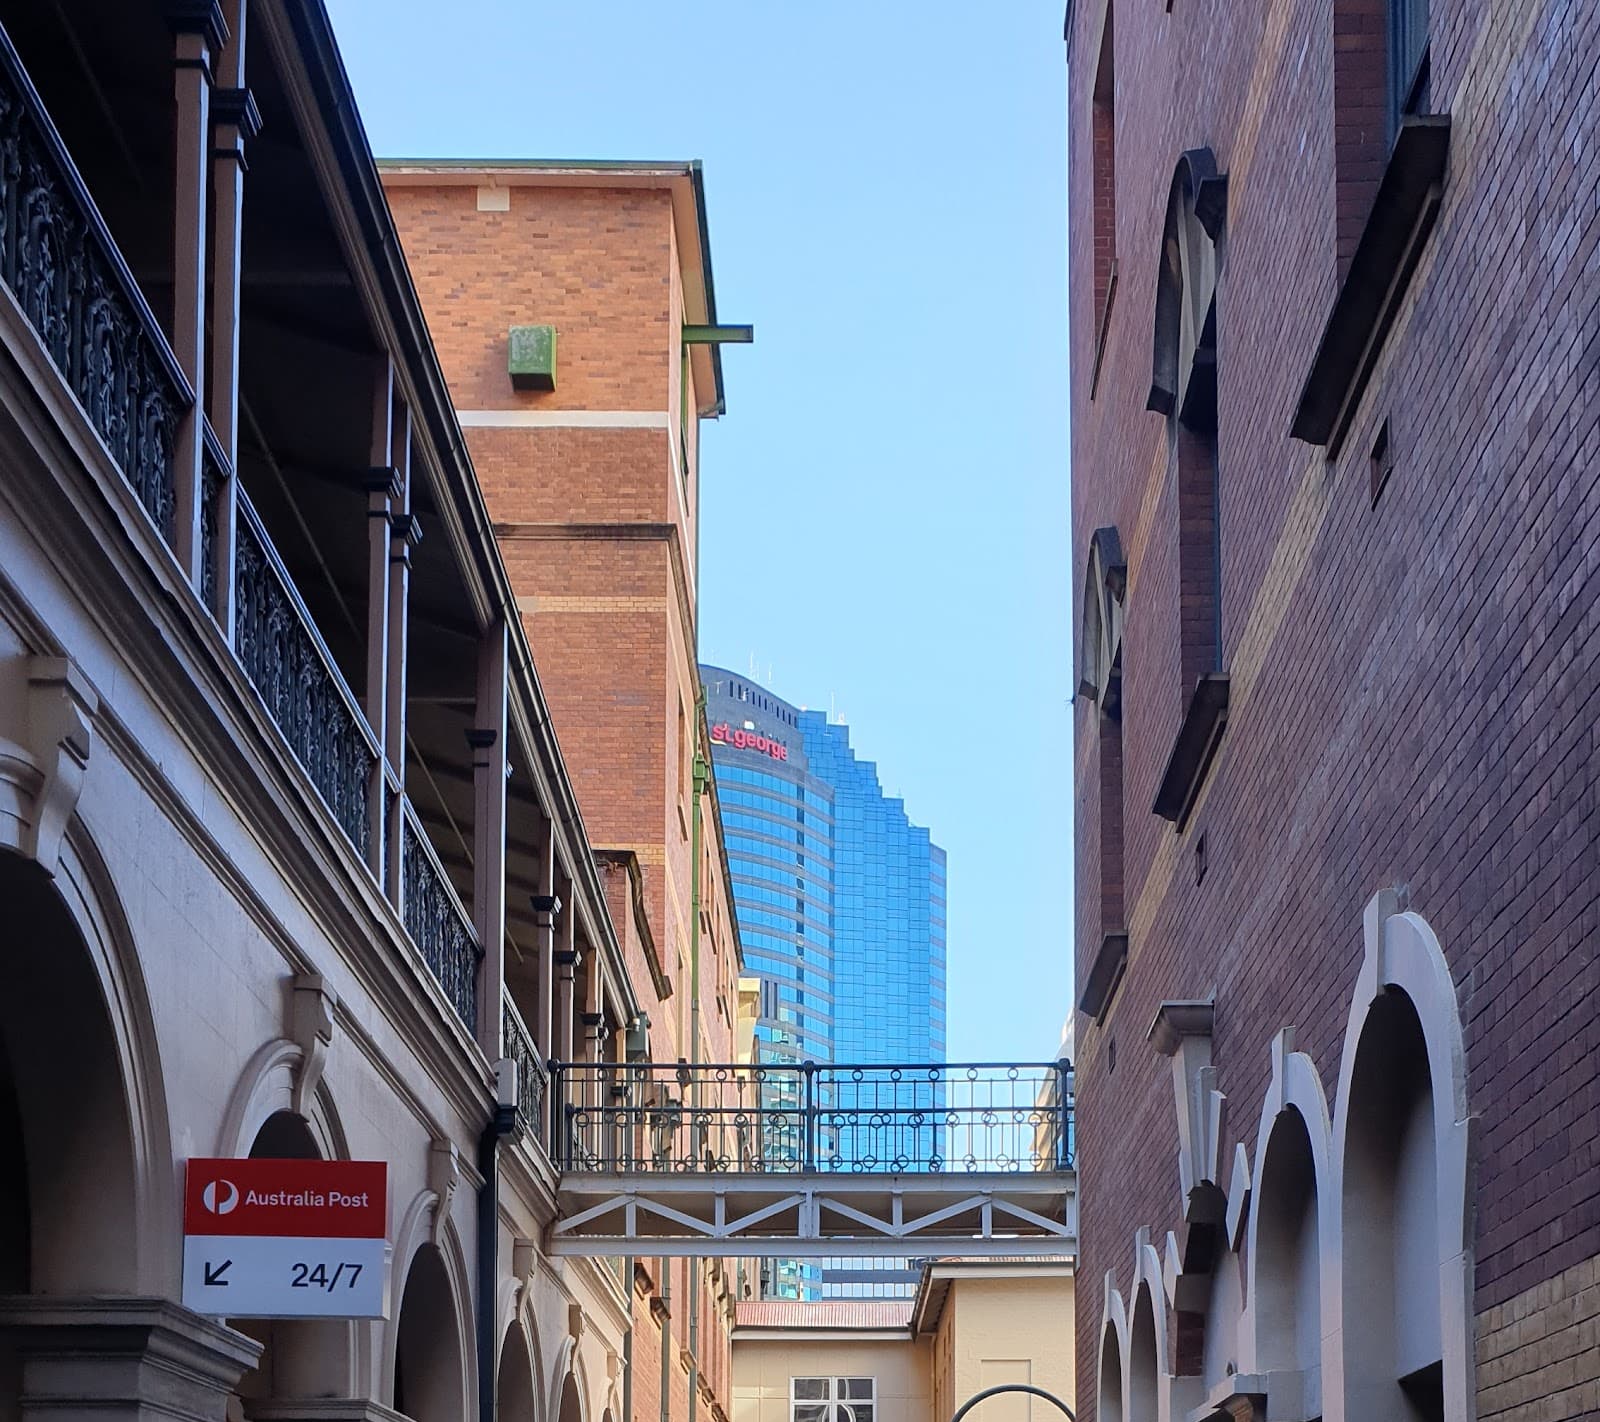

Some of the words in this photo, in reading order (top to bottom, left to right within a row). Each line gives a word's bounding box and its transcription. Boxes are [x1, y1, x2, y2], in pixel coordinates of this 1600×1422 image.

[245, 1190, 325, 1207] Australia
[328, 1192, 369, 1208] Post
[291, 1263, 363, 1292] 24/7
